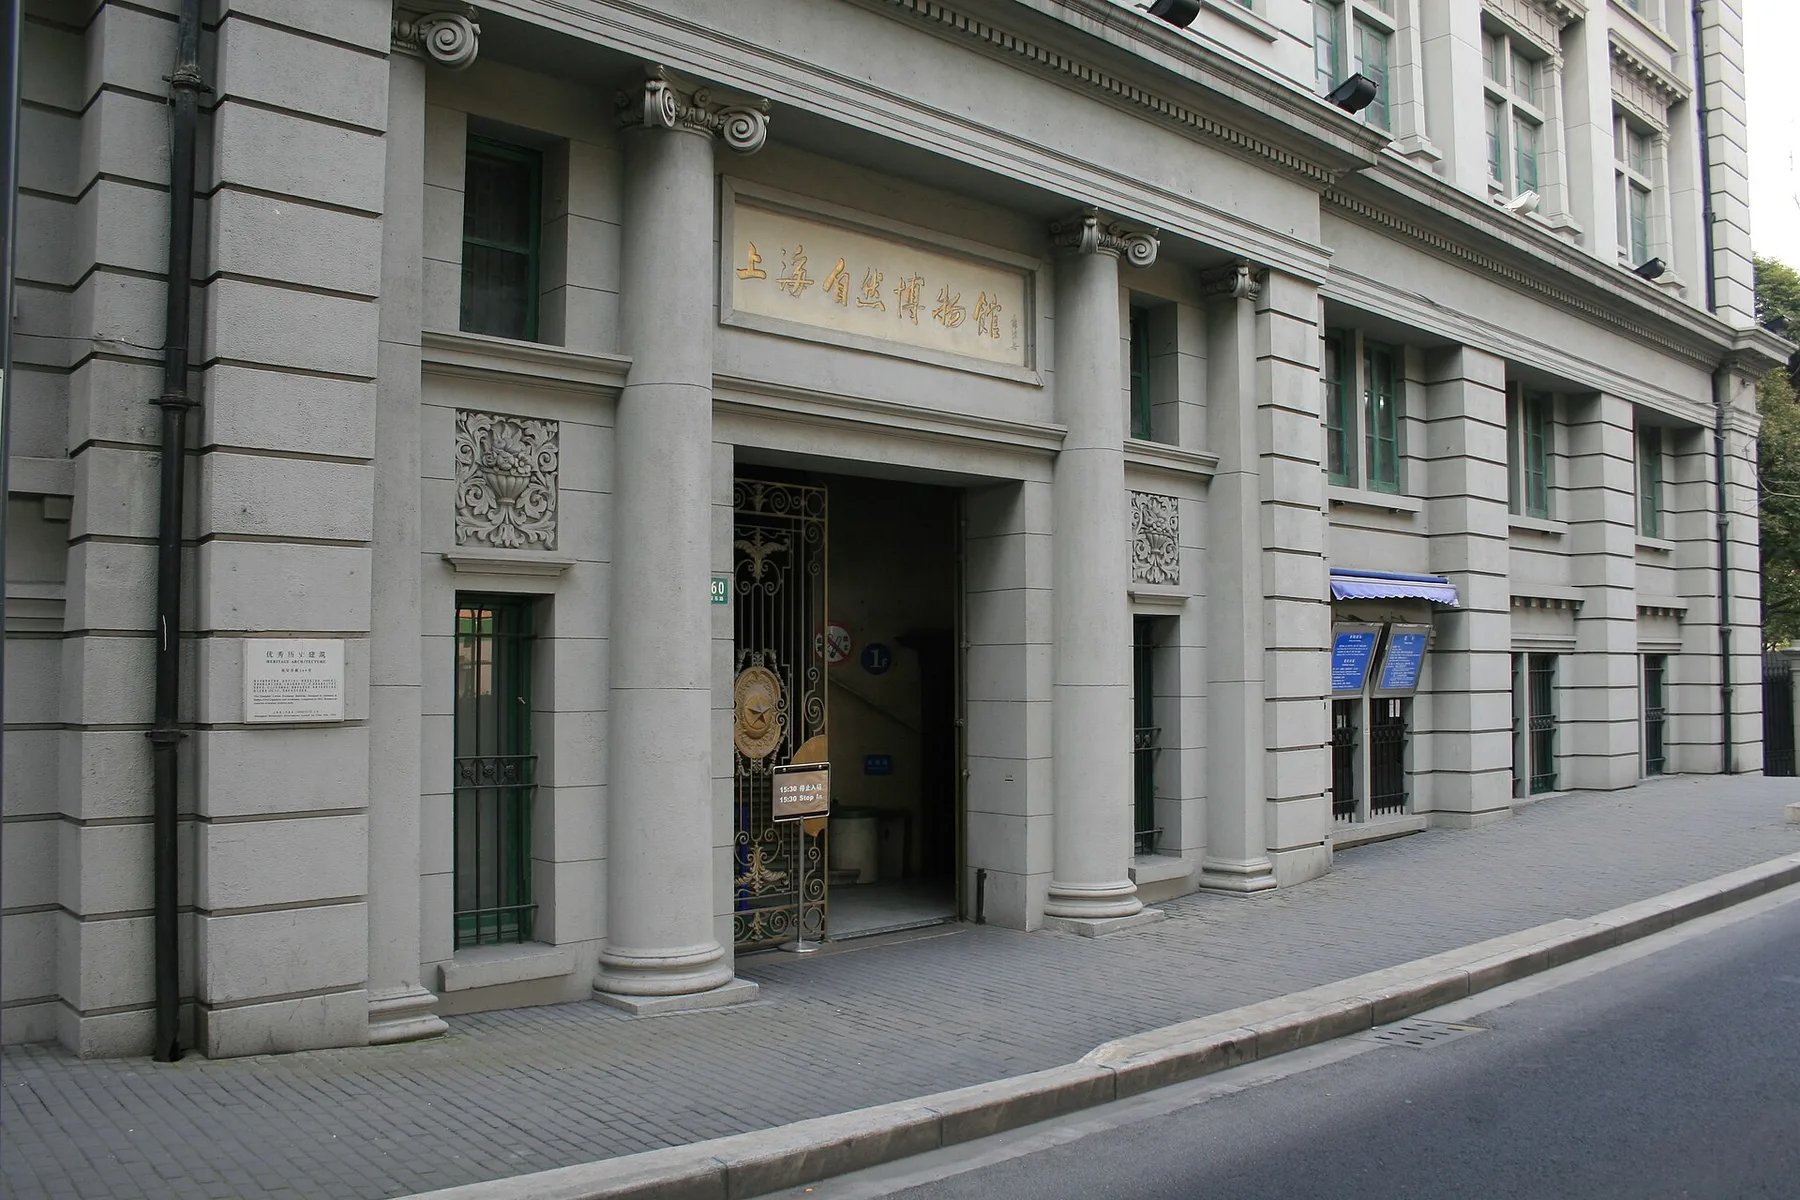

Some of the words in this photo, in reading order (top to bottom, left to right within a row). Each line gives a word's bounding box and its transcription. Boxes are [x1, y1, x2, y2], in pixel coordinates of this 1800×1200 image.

[780, 785, 798, 793] 15:30
[779, 795, 798, 803] 15:30
[799, 794, 815, 802] Stop
